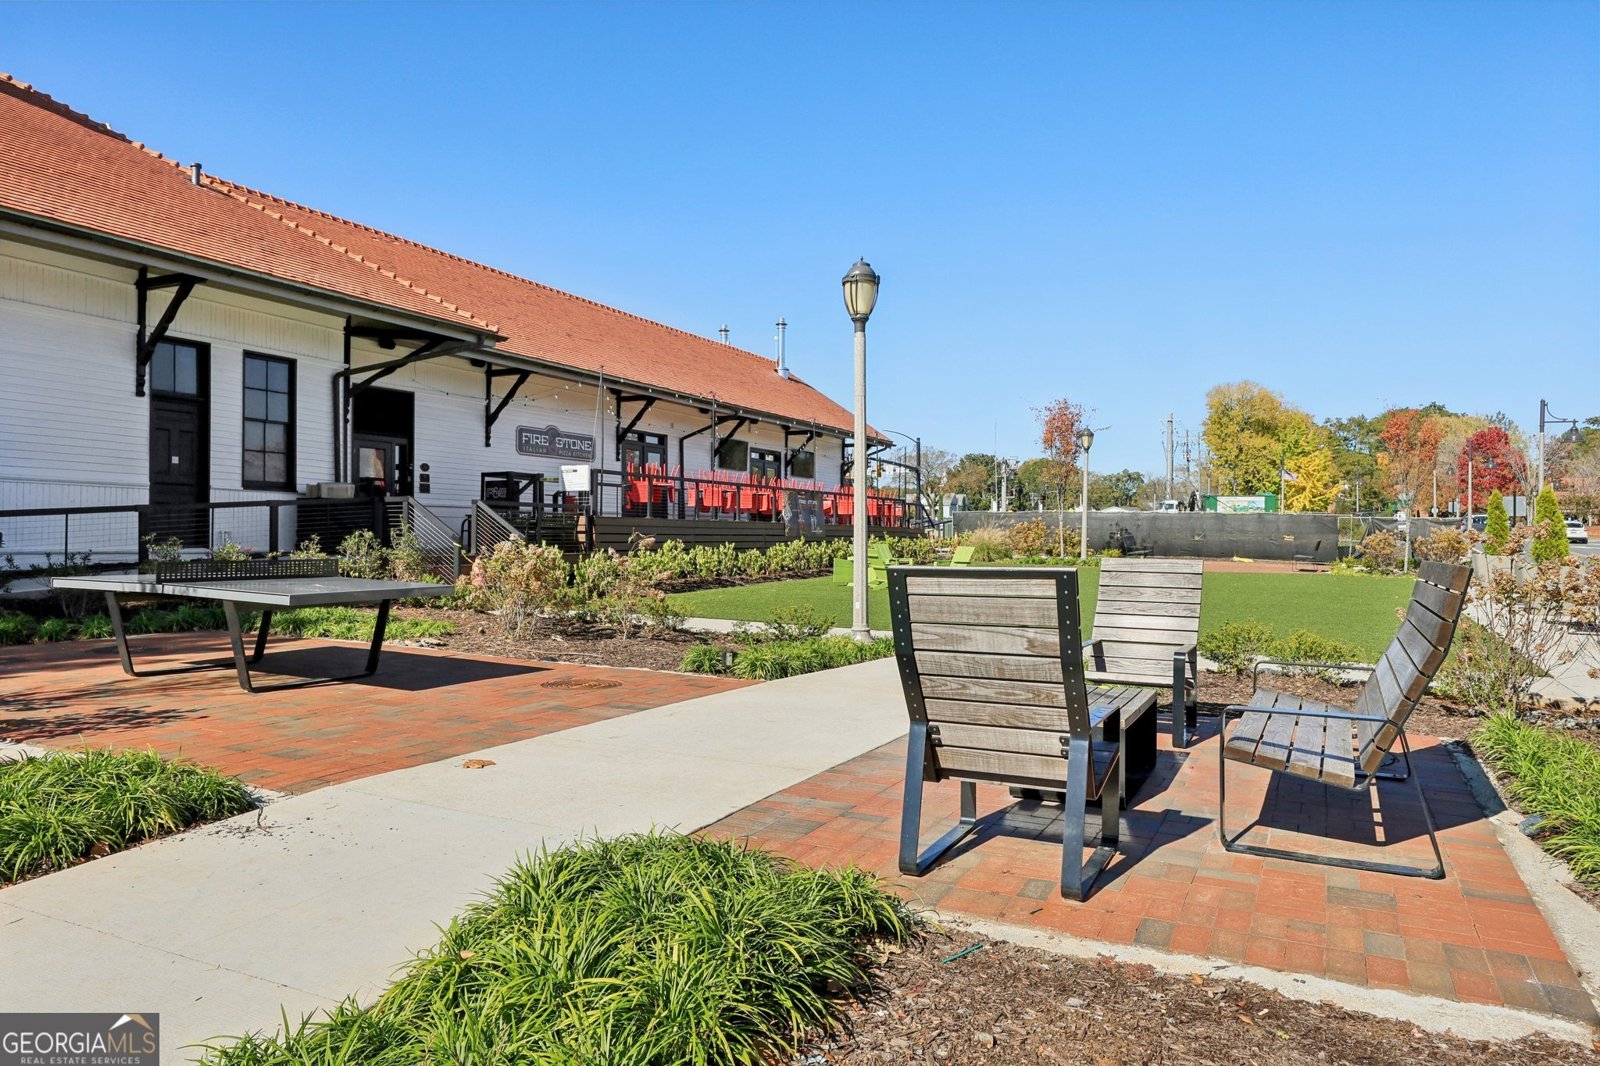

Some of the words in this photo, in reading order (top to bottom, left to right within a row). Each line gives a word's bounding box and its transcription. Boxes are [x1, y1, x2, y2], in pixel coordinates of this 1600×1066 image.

[522, 433, 549, 446] FIRE
[555, 437, 592, 451] STONE
[523, 446, 547, 454] ITALIAN
